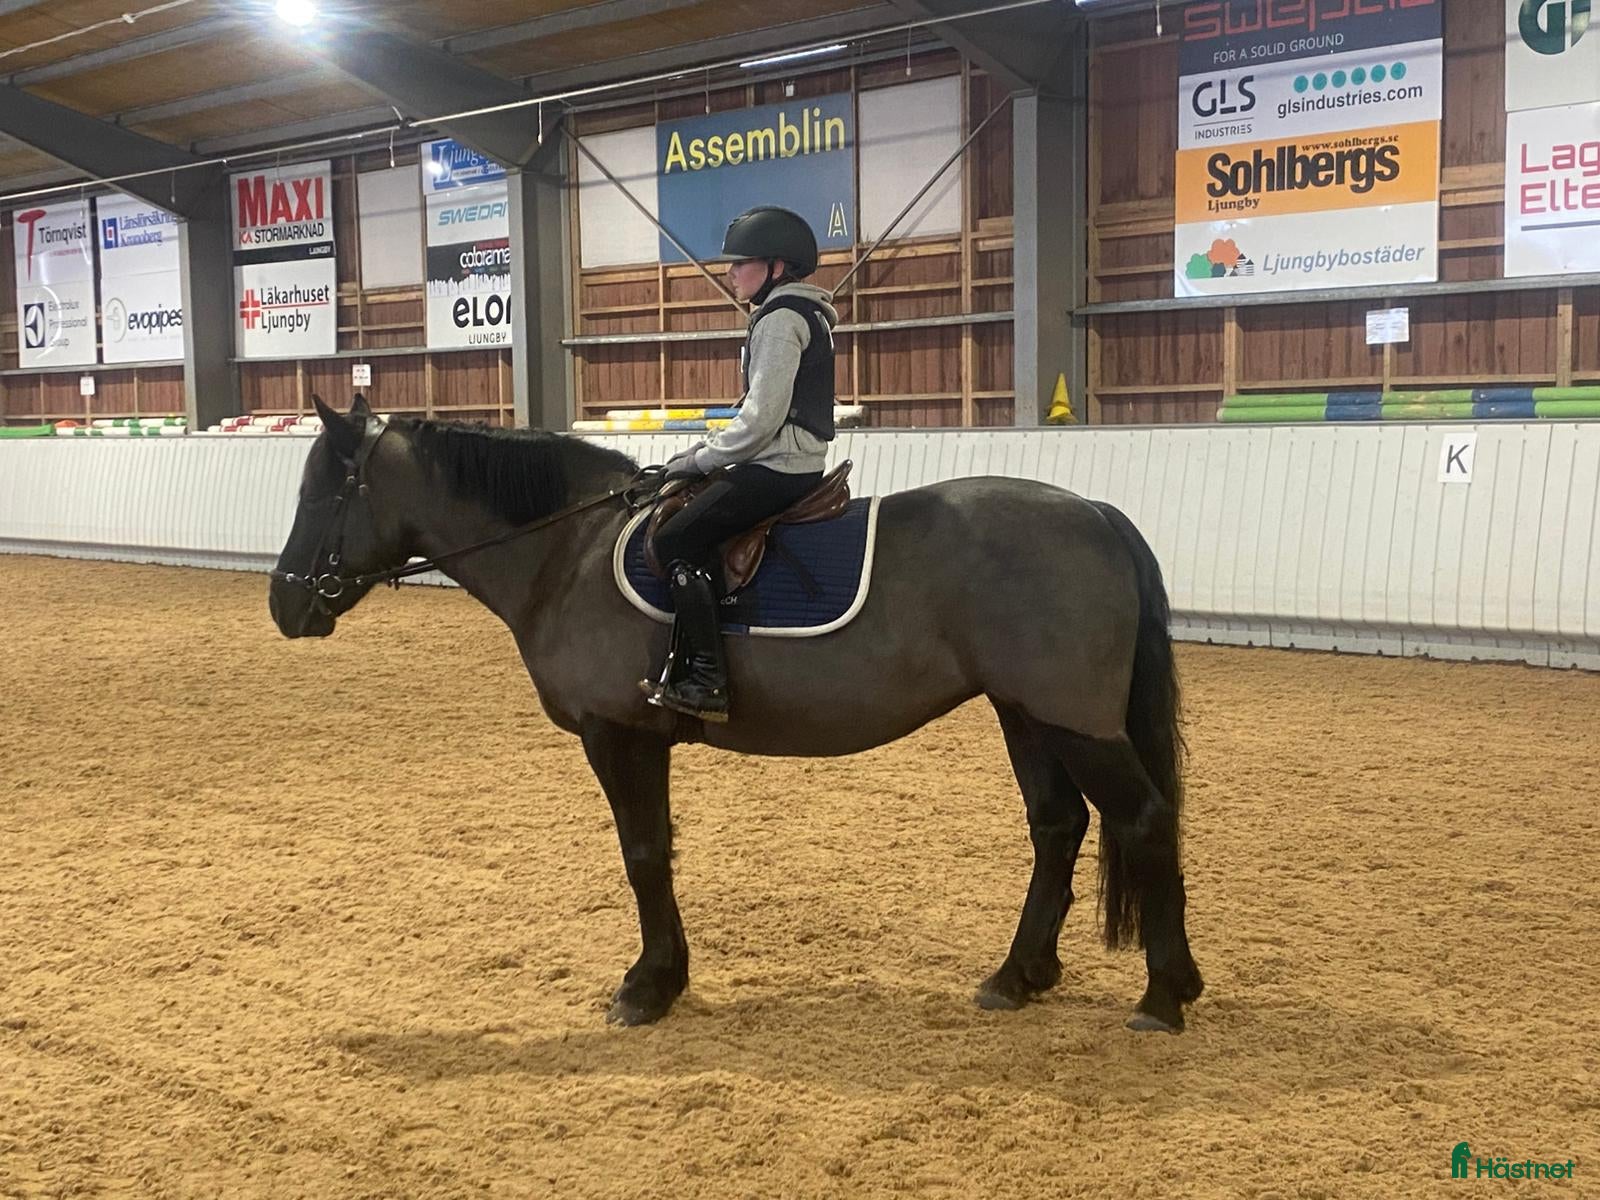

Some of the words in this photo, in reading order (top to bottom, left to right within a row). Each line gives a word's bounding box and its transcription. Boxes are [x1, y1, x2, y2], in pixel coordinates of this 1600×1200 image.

[1213, 50, 1236, 65] FOR
[1239, 48, 1248, 60] A
[1251, 43, 1286, 59] SOLID
[1290, 33, 1344, 53] GROUND
[1192, 75, 1256, 117] GLS
[1277, 85, 1423, 118] glsindustries.com
[664, 107, 845, 174] Assemblin
[1194, 124, 1253, 140] INDUSTRIES
[1301, 135, 1400, 152] www.sohlbergs.se
[1207, 145, 1400, 198] Sohlbergs
[237, 175, 324, 229] MAXI
[1208, 196, 1260, 212] Ljungby
[1520, 178, 1600, 214] Elte
[39, 223, 87, 246] Törnqvist
[254, 222, 325, 244] STORMARKNAD
[459, 245, 511, 268] colorama
[1263, 245, 1425, 275] Ljungbybostäder
[260, 284, 330, 306] Läkarhuset
[128, 303, 183, 335] evopipes
[261, 310, 311, 334] Ljungby
[468, 331, 507, 344] LJUNGBY
[1446, 444, 1470, 474] K
